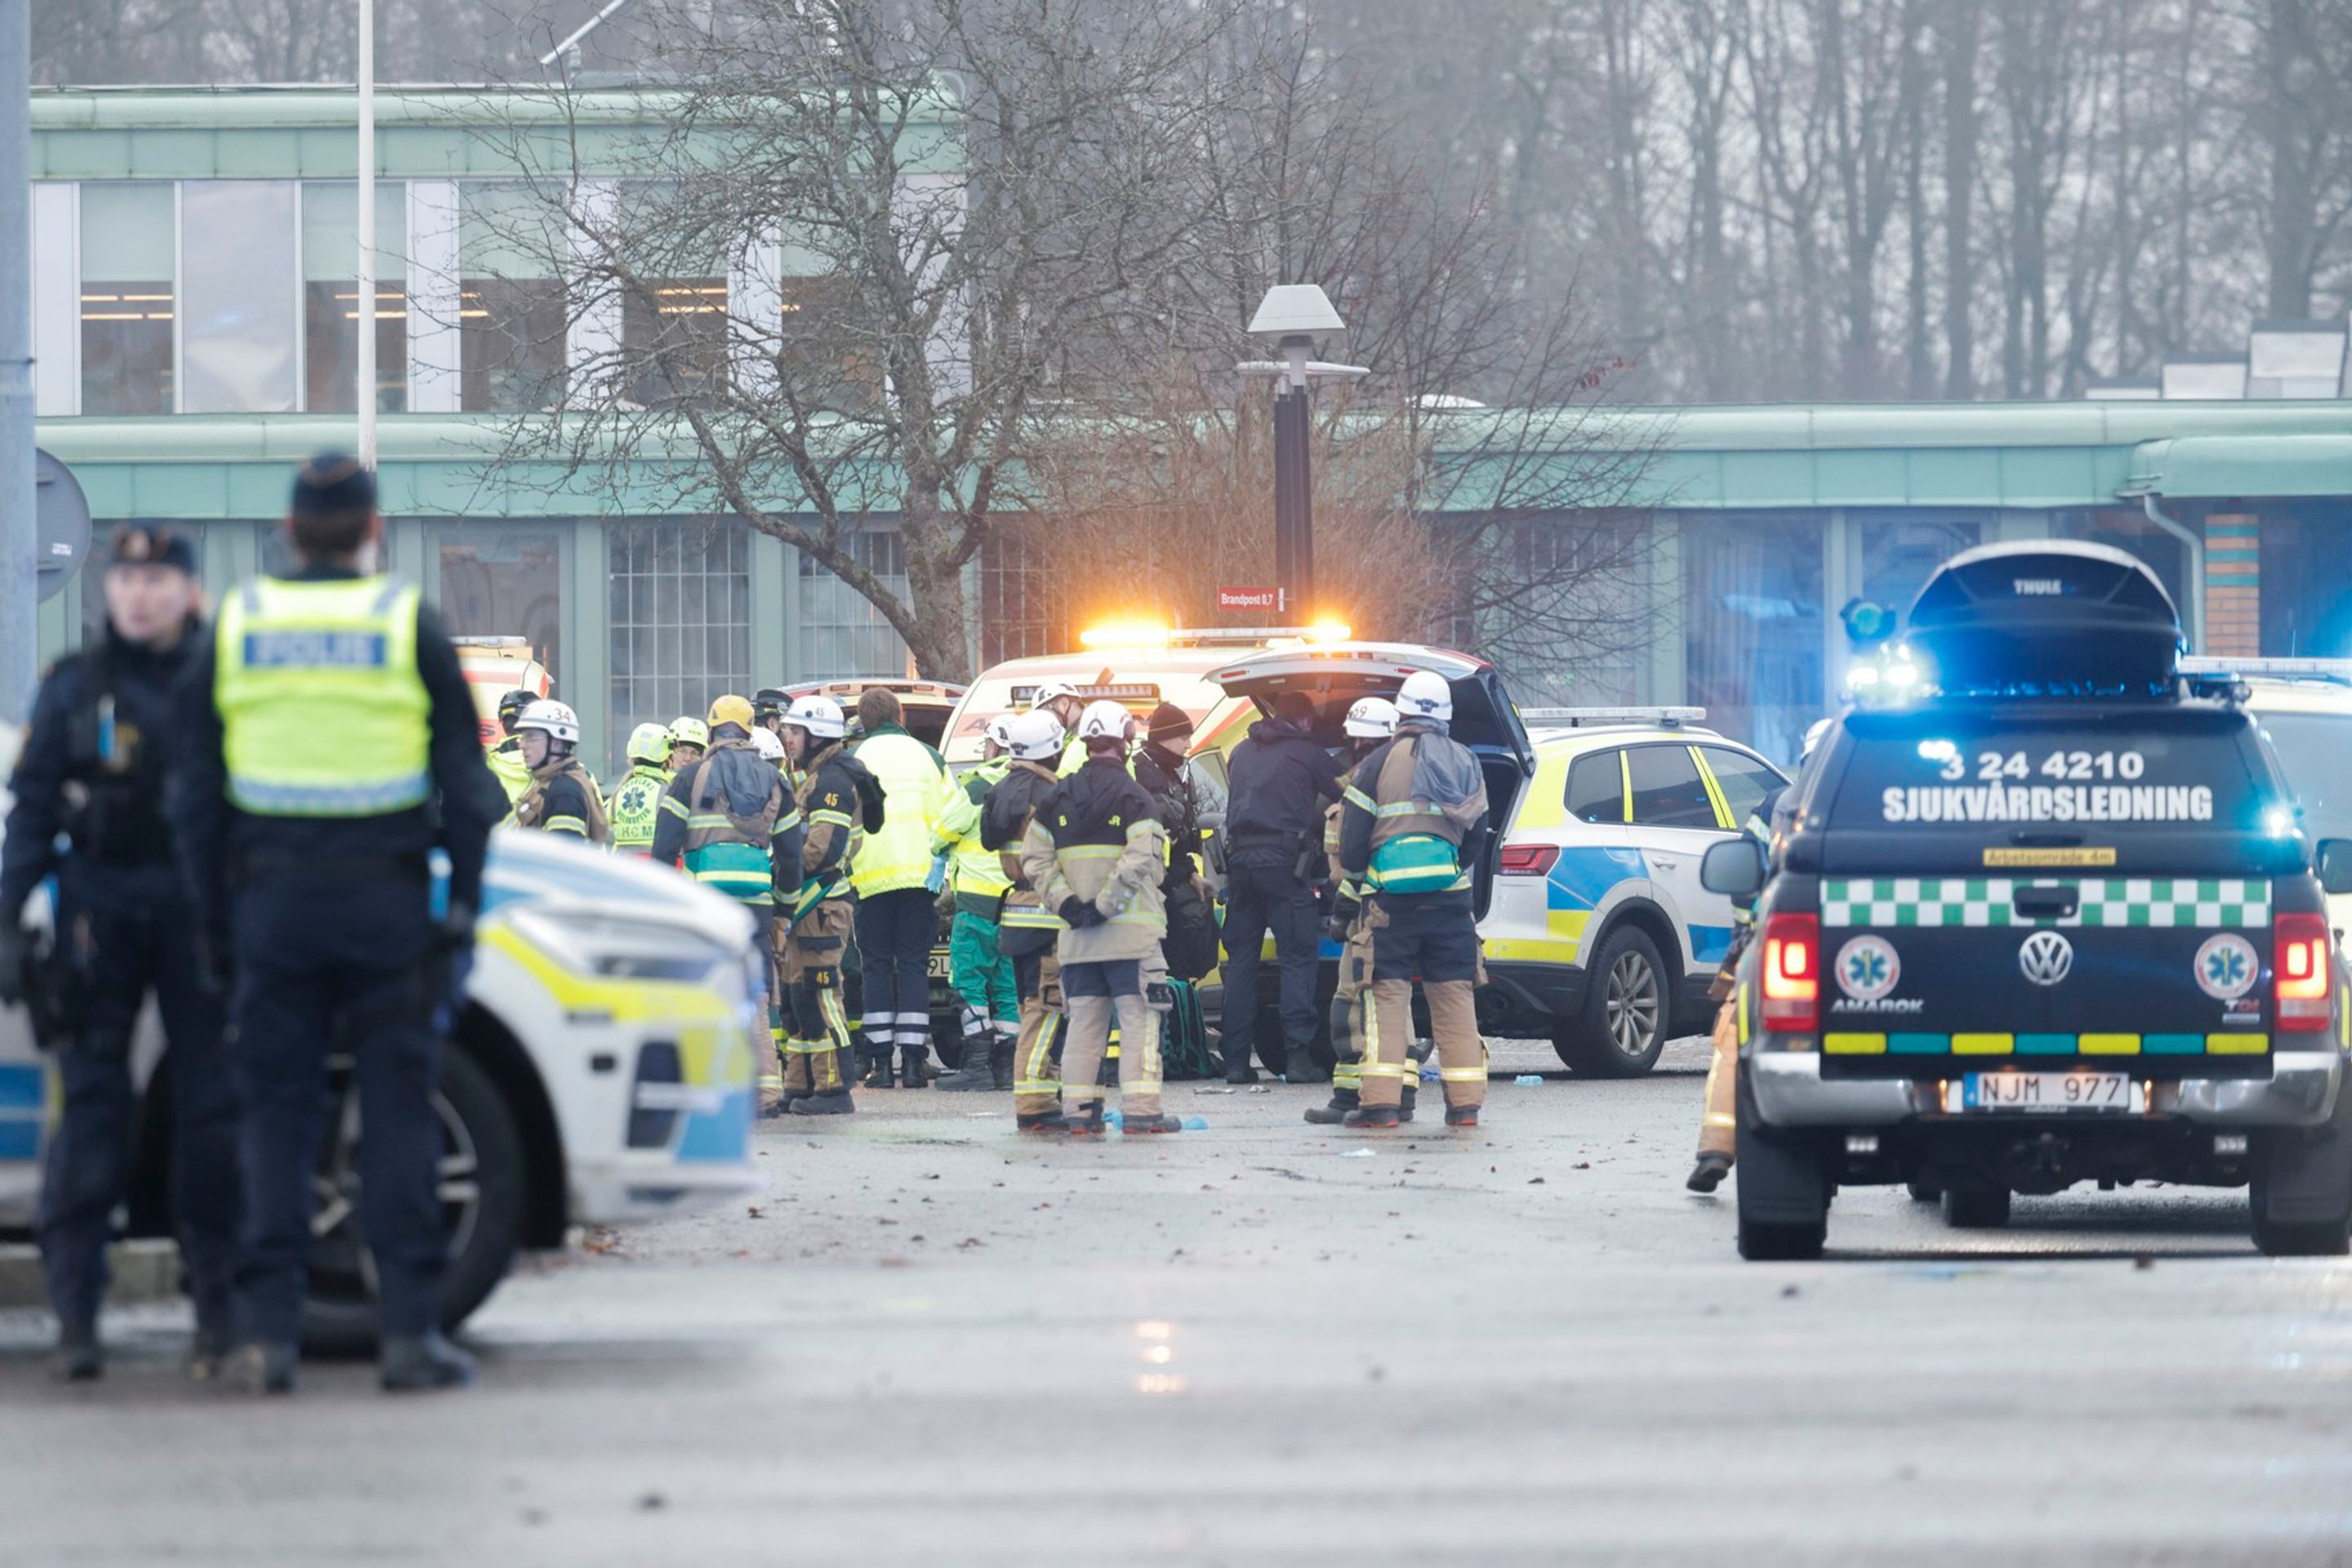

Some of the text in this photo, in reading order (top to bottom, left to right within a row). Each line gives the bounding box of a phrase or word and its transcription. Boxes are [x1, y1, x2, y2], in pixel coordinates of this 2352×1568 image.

[2013, 579, 2061, 595] THULE
[1221, 593, 1273, 607] Brandpost 0,7
[257, 634, 374, 667] POLIS
[555, 707, 571, 722] 34
[1940, 751, 2145, 781] 3 24 4210
[825, 792, 838, 807] 45
[1882, 780, 2213, 822] SJUKVÅRDSLEDNING
[1831, 998, 1925, 1013] AMAROK
[1983, 1076, 2121, 1102] NJM 977
